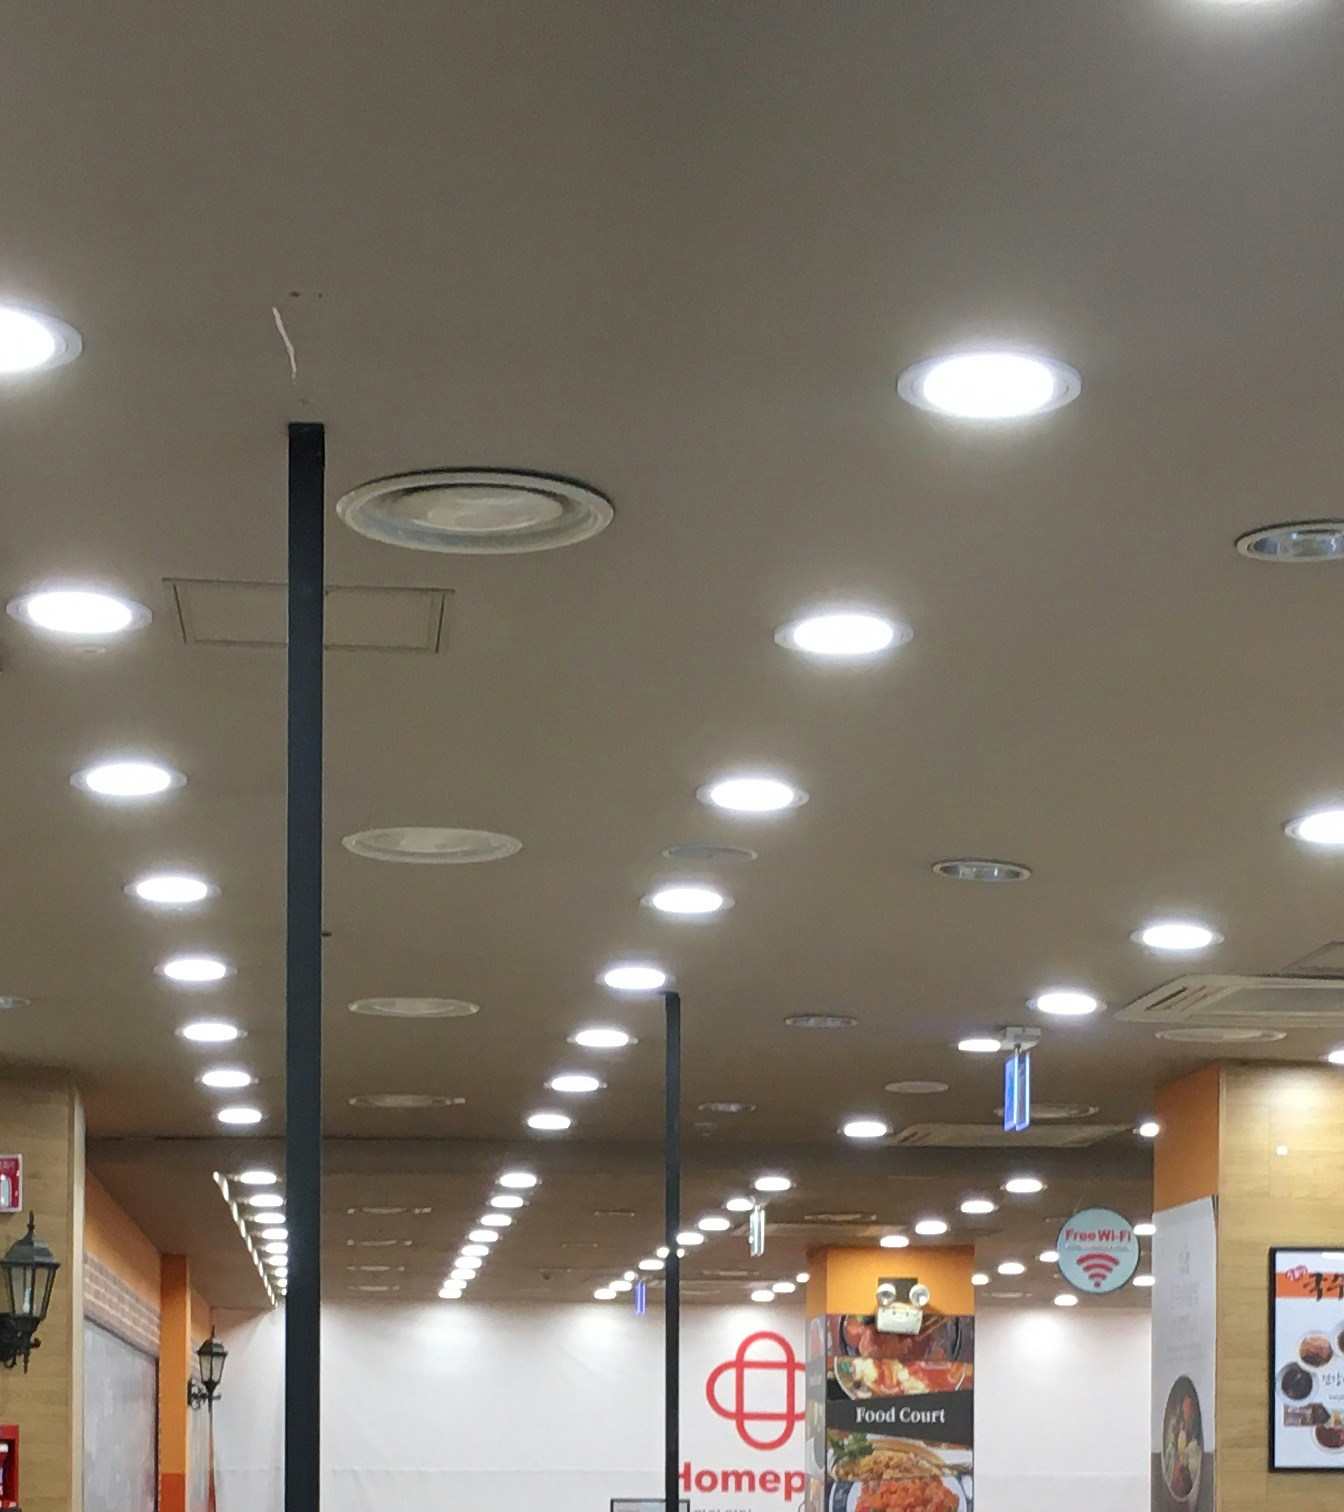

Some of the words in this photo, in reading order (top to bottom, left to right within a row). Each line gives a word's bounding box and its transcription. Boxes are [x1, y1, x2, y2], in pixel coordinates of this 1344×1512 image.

[1065, 1228, 1096, 1241] Free
[855, 1406, 896, 1423] Food
[899, 1406, 946, 1424] Court
